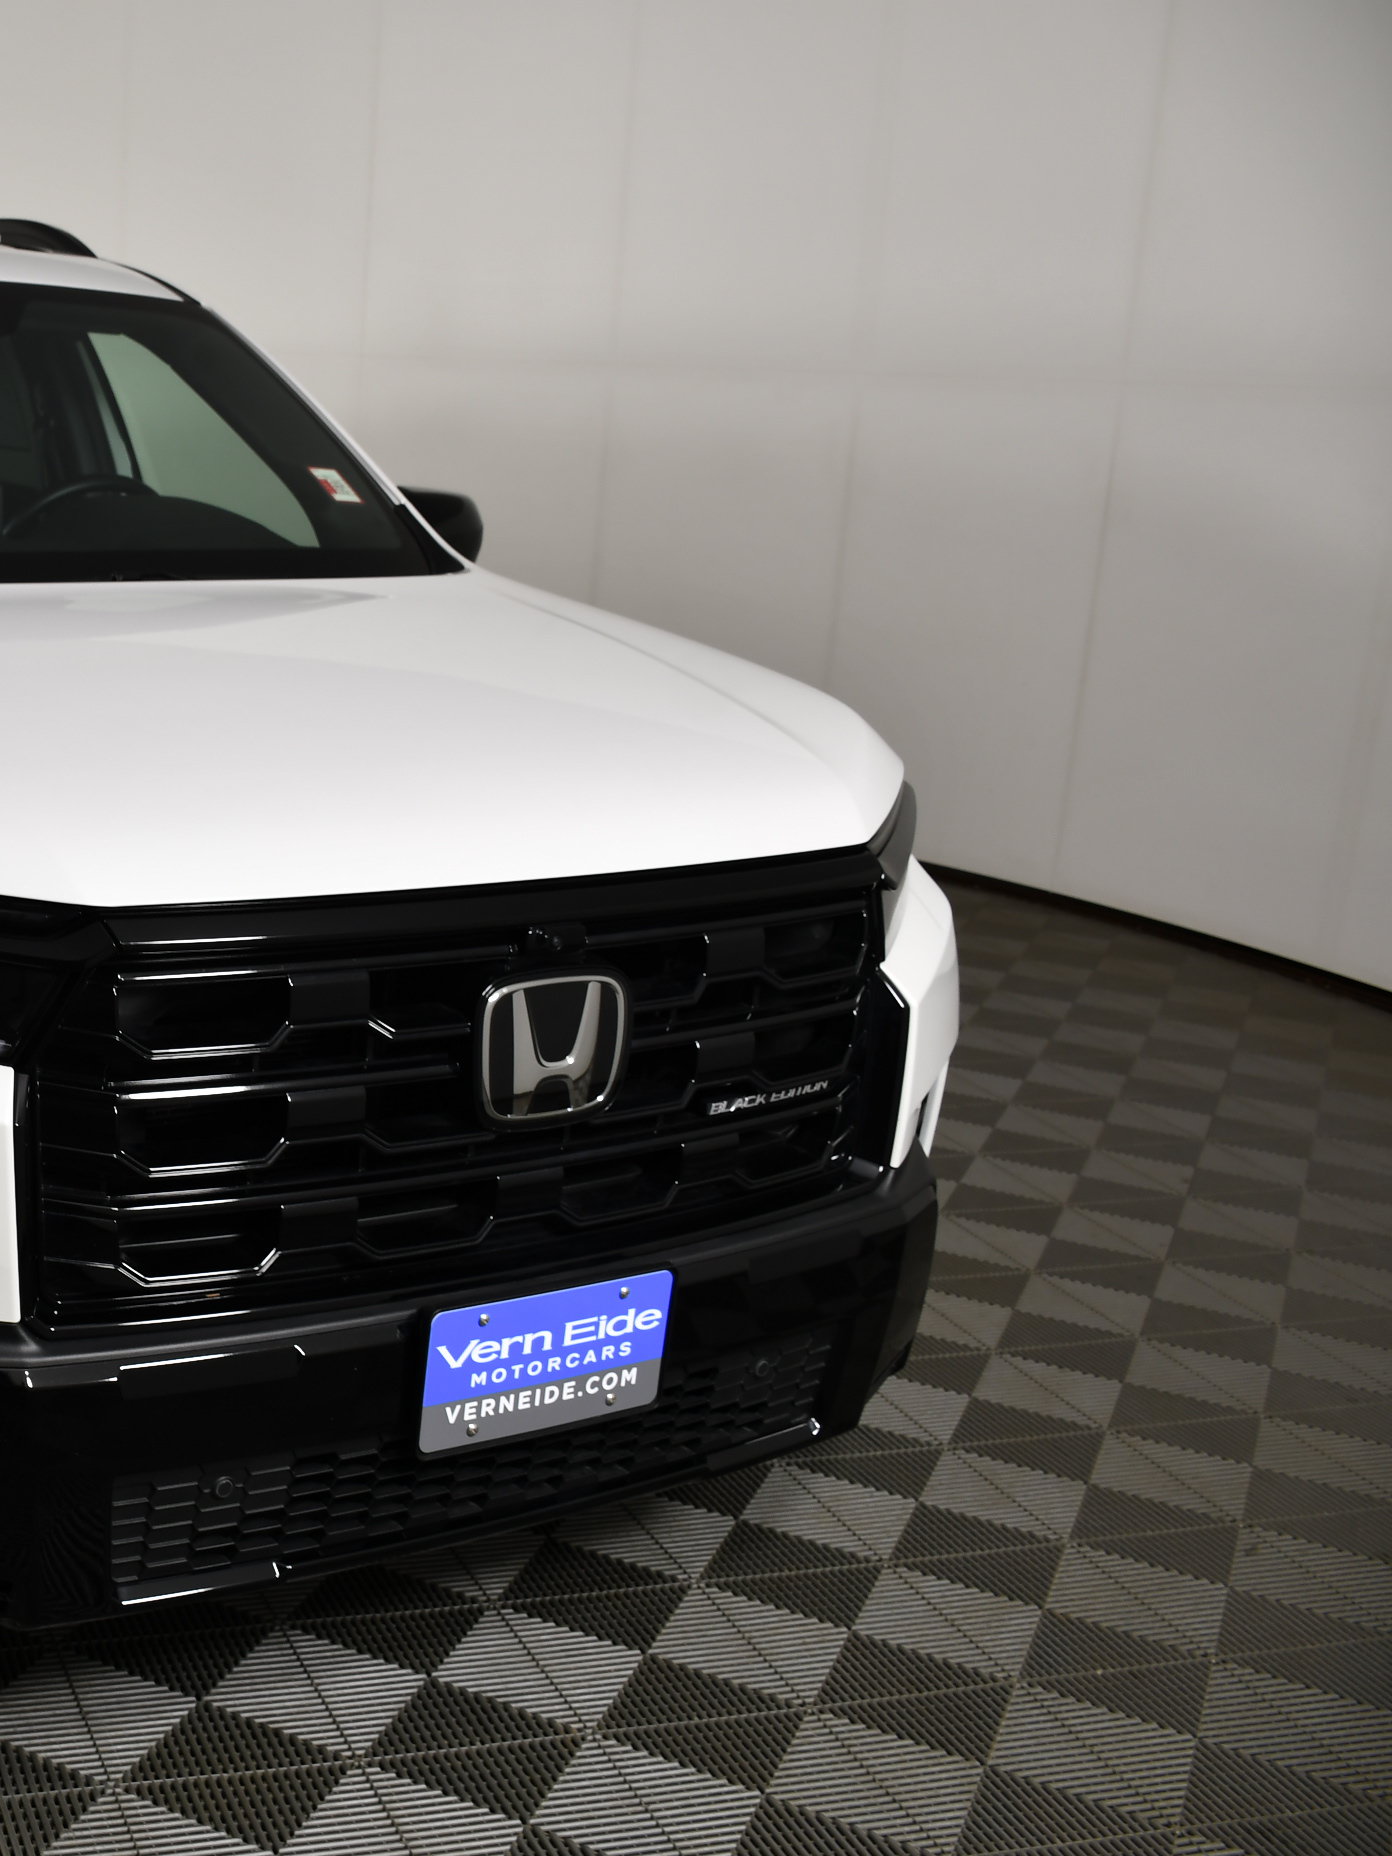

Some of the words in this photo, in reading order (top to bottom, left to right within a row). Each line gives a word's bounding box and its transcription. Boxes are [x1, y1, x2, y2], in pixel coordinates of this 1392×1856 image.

[709, 1093, 766, 1115] BLACK
[436, 1330, 552, 1369] Vern
[562, 1308, 663, 1347] Eide
[470, 1341, 632, 1388] MOTORCARS
[445, 1367, 638, 1424] VERNEIDE.COM
